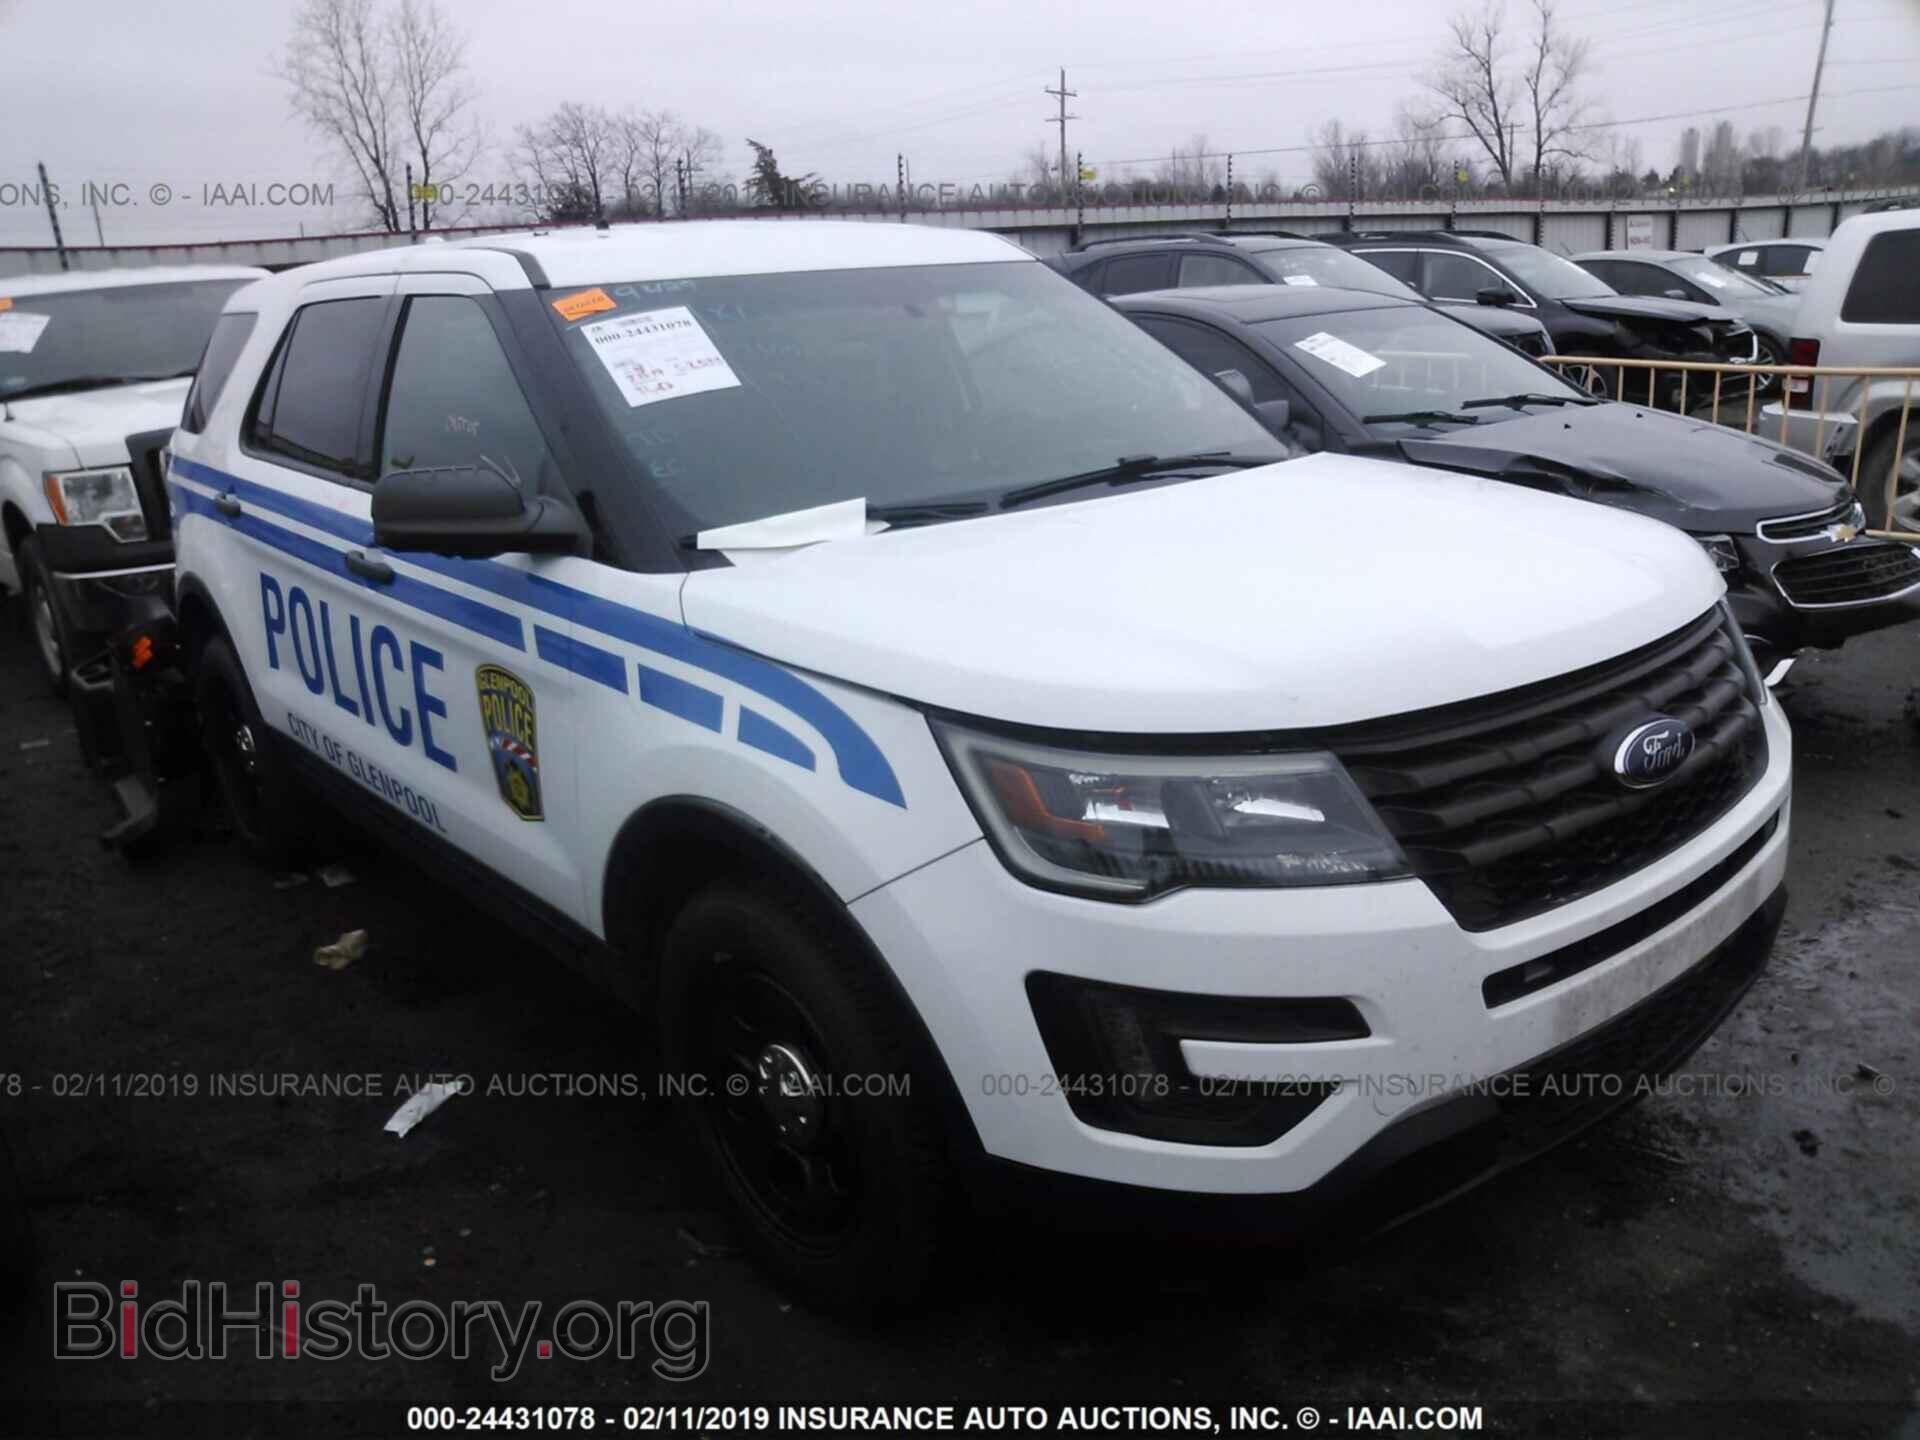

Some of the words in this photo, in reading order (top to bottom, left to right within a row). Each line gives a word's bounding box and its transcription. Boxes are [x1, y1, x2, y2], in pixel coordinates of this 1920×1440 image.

[260, 572, 458, 773] POLICE
[481, 694, 534, 750] POLICE
[1642, 729, 1686, 771] Ford
[287, 711, 319, 752] CITY
[322, 735, 343, 767] OF
[348, 750, 447, 834] GLENPOOL
